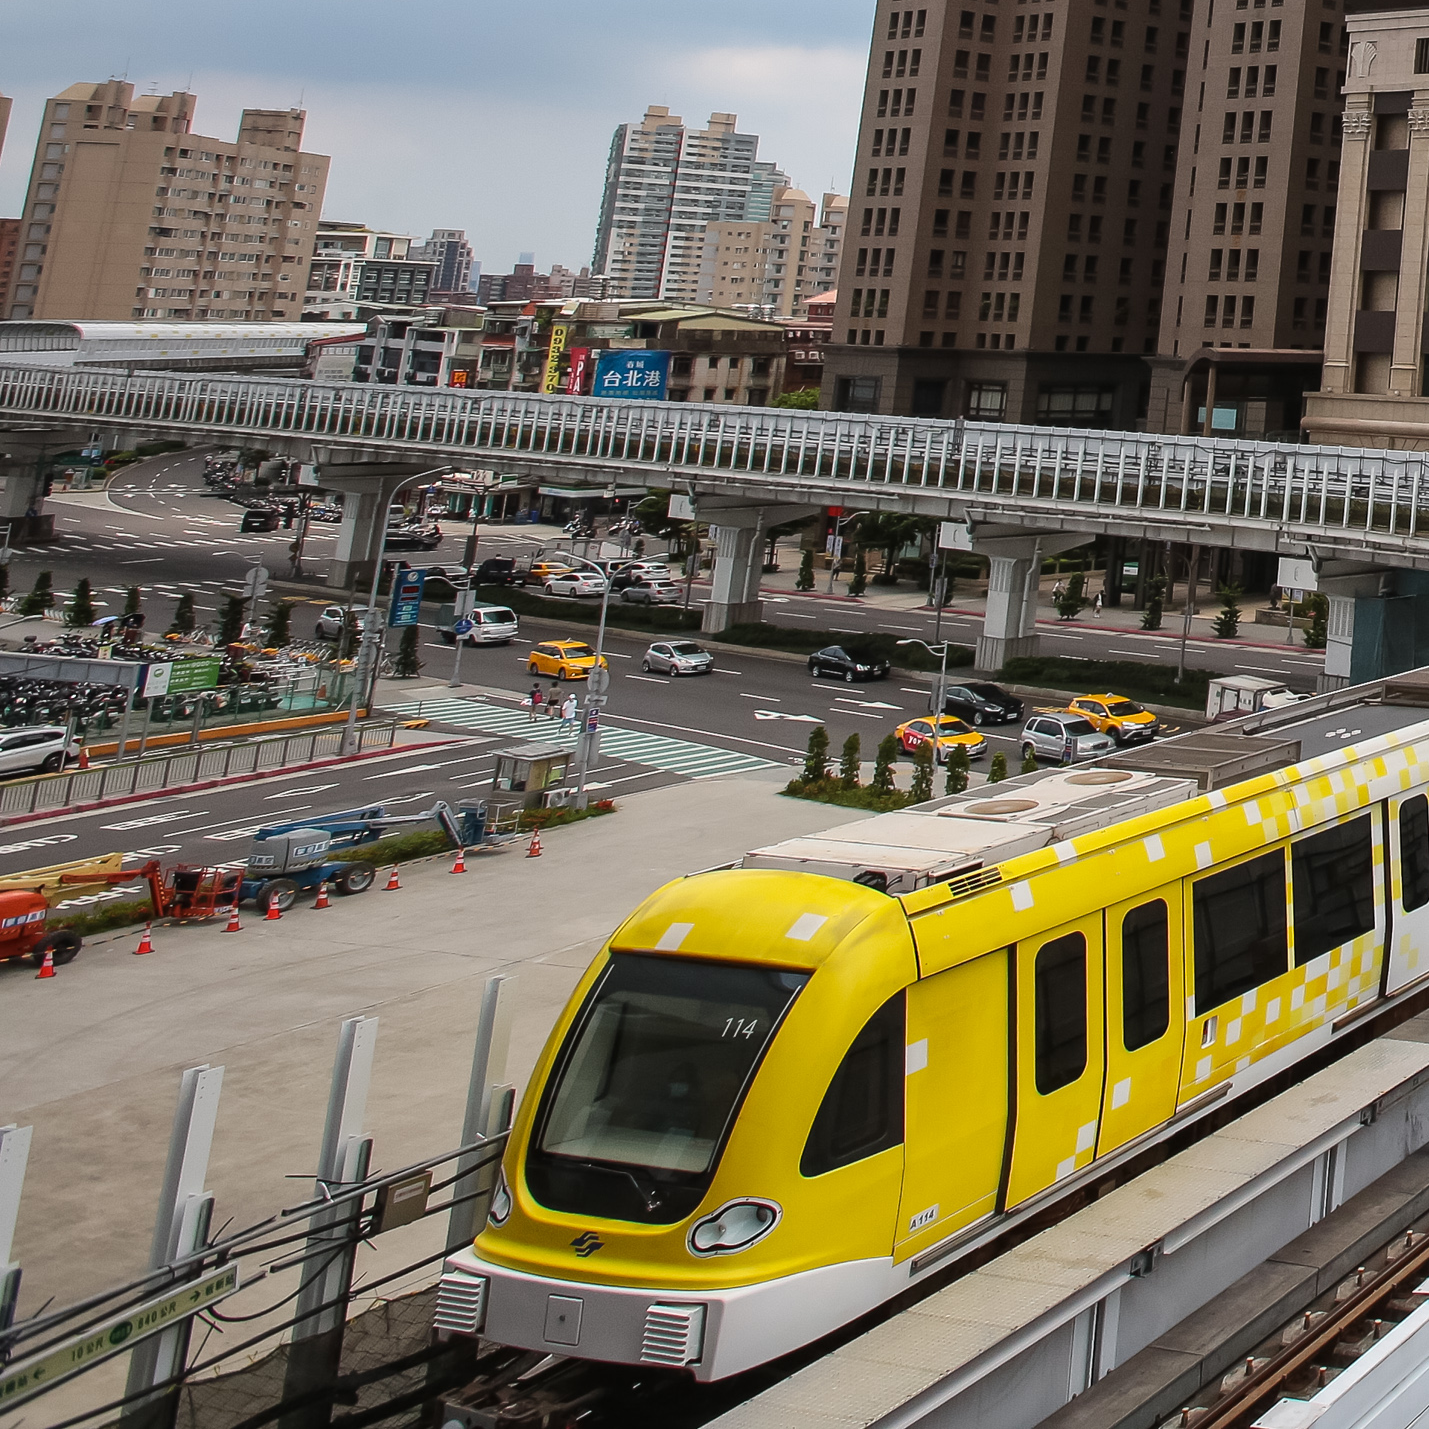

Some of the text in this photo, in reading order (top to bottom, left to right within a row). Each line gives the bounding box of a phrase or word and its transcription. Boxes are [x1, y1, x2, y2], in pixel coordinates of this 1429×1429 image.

[572, 361, 584, 394] PA
[603, 369, 661, 387] 台北港
[721, 1017, 758, 1040] 114
